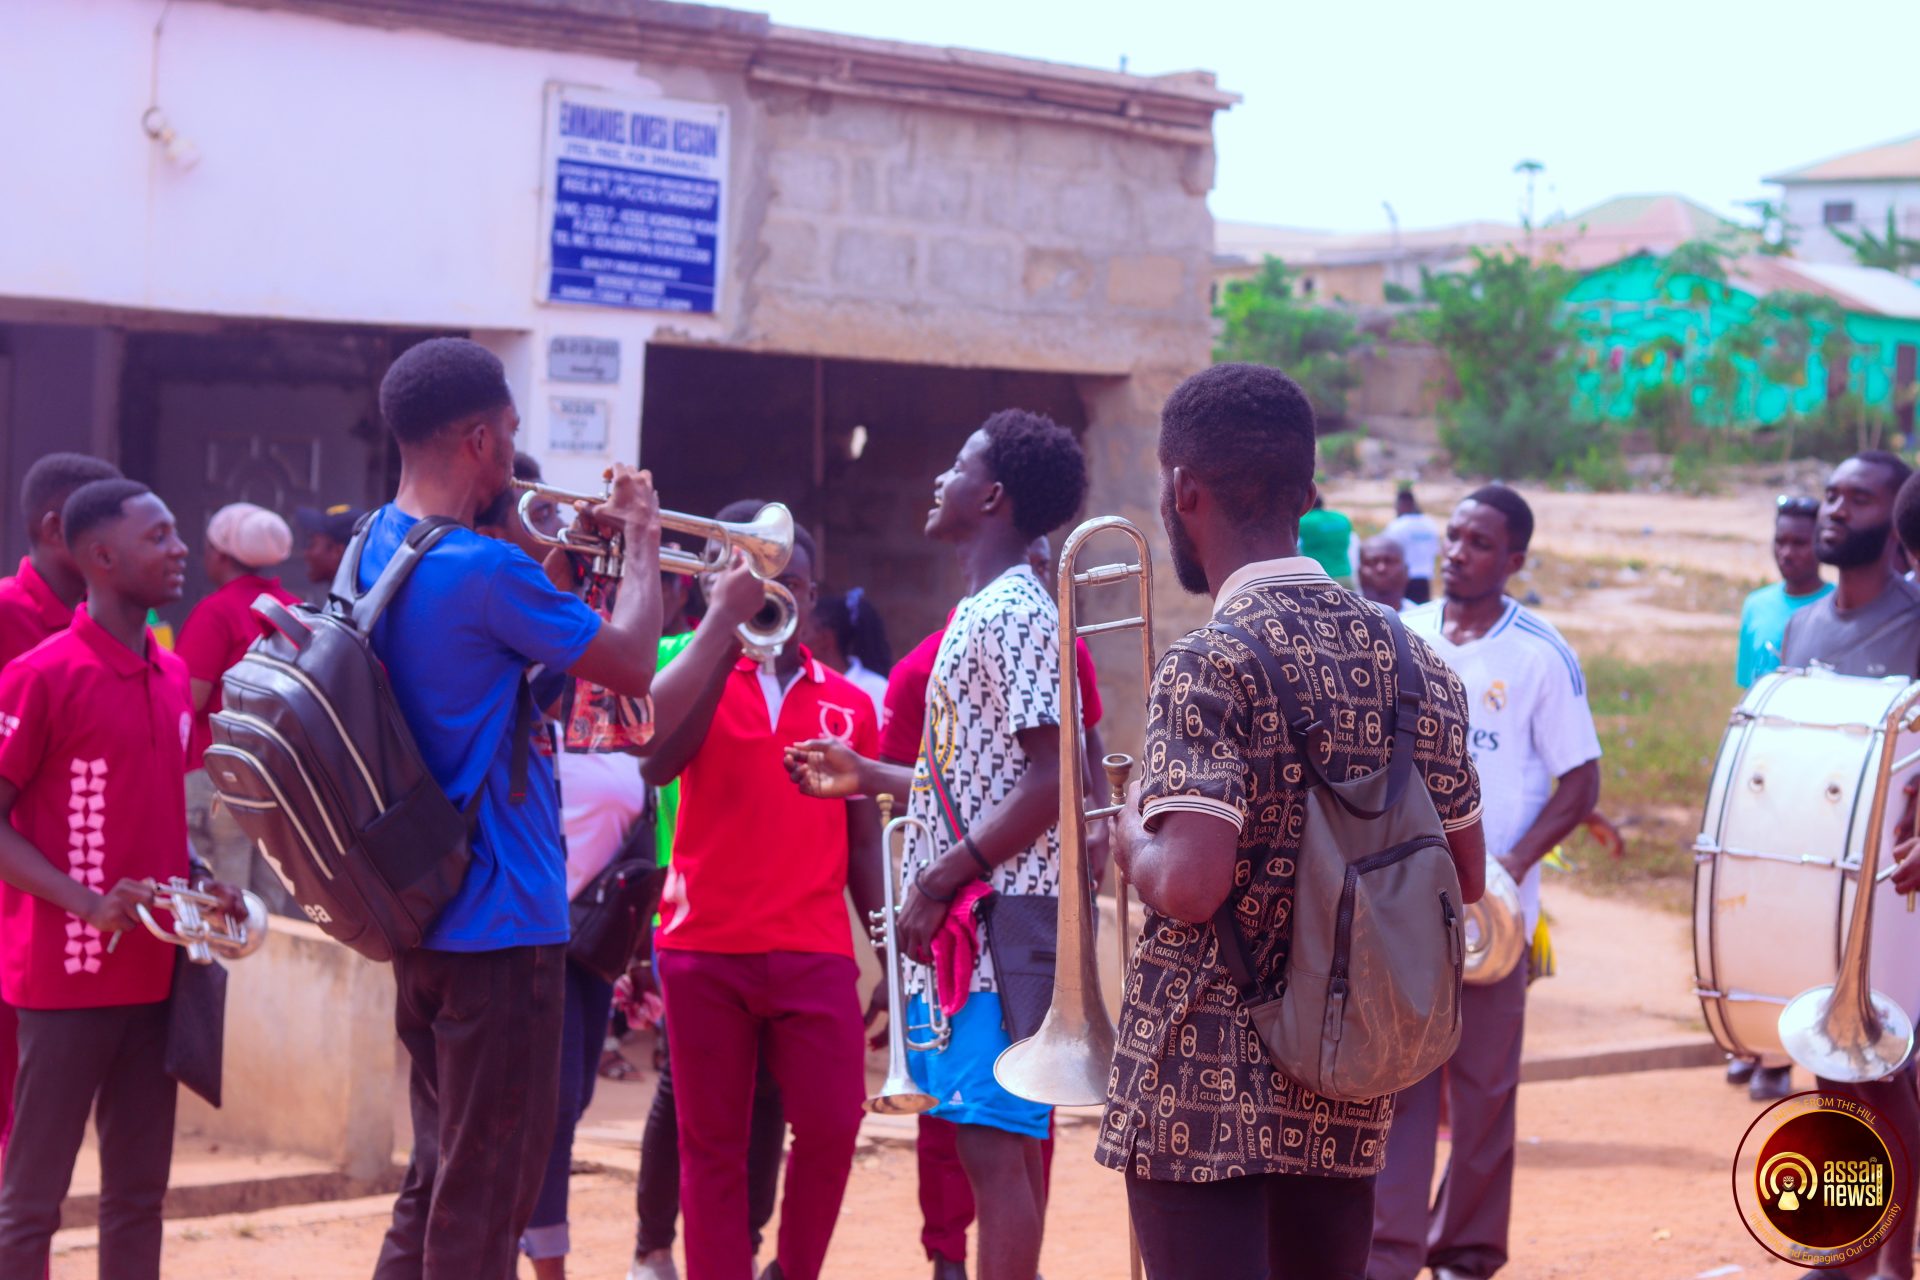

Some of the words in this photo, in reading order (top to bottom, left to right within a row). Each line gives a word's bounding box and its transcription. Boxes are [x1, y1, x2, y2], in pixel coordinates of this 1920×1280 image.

[1175, 707, 1183, 740] GUGUI
[1467, 728, 1499, 751] es
[1155, 946, 1180, 960] GUGUI
[1168, 1026, 1178, 1056] GUGUI
[1158, 1119, 1167, 1153] GUGUI
